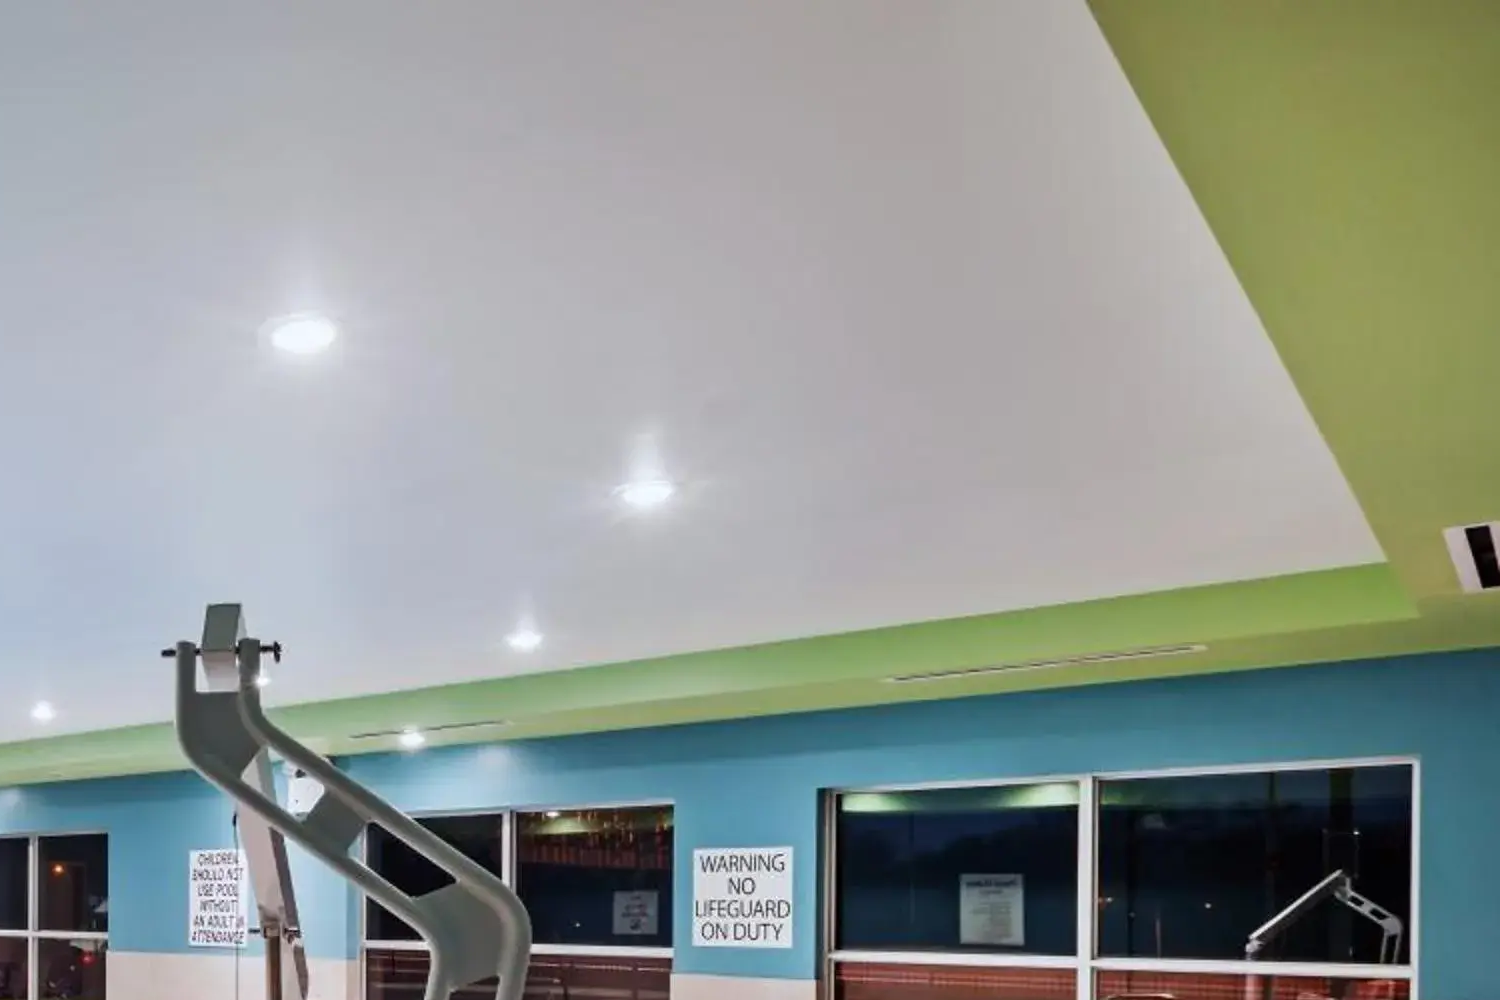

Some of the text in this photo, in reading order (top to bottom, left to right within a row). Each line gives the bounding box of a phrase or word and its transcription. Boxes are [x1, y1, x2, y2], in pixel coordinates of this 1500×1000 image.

[700, 853, 785, 873] WARNING
[192, 868, 244, 881] SHOULD NOT
[197, 884, 239, 897] USE POOL
[727, 877, 756, 895] NO
[199, 899, 237, 912] WITHOUT
[695, 899, 791, 918] LIFEGUARD
[193, 915, 205, 928] AN
[207, 915, 234, 928] ADULT
[192, 930, 245, 944] ATTENDANCE
[701, 921, 784, 941] ON DUTY
